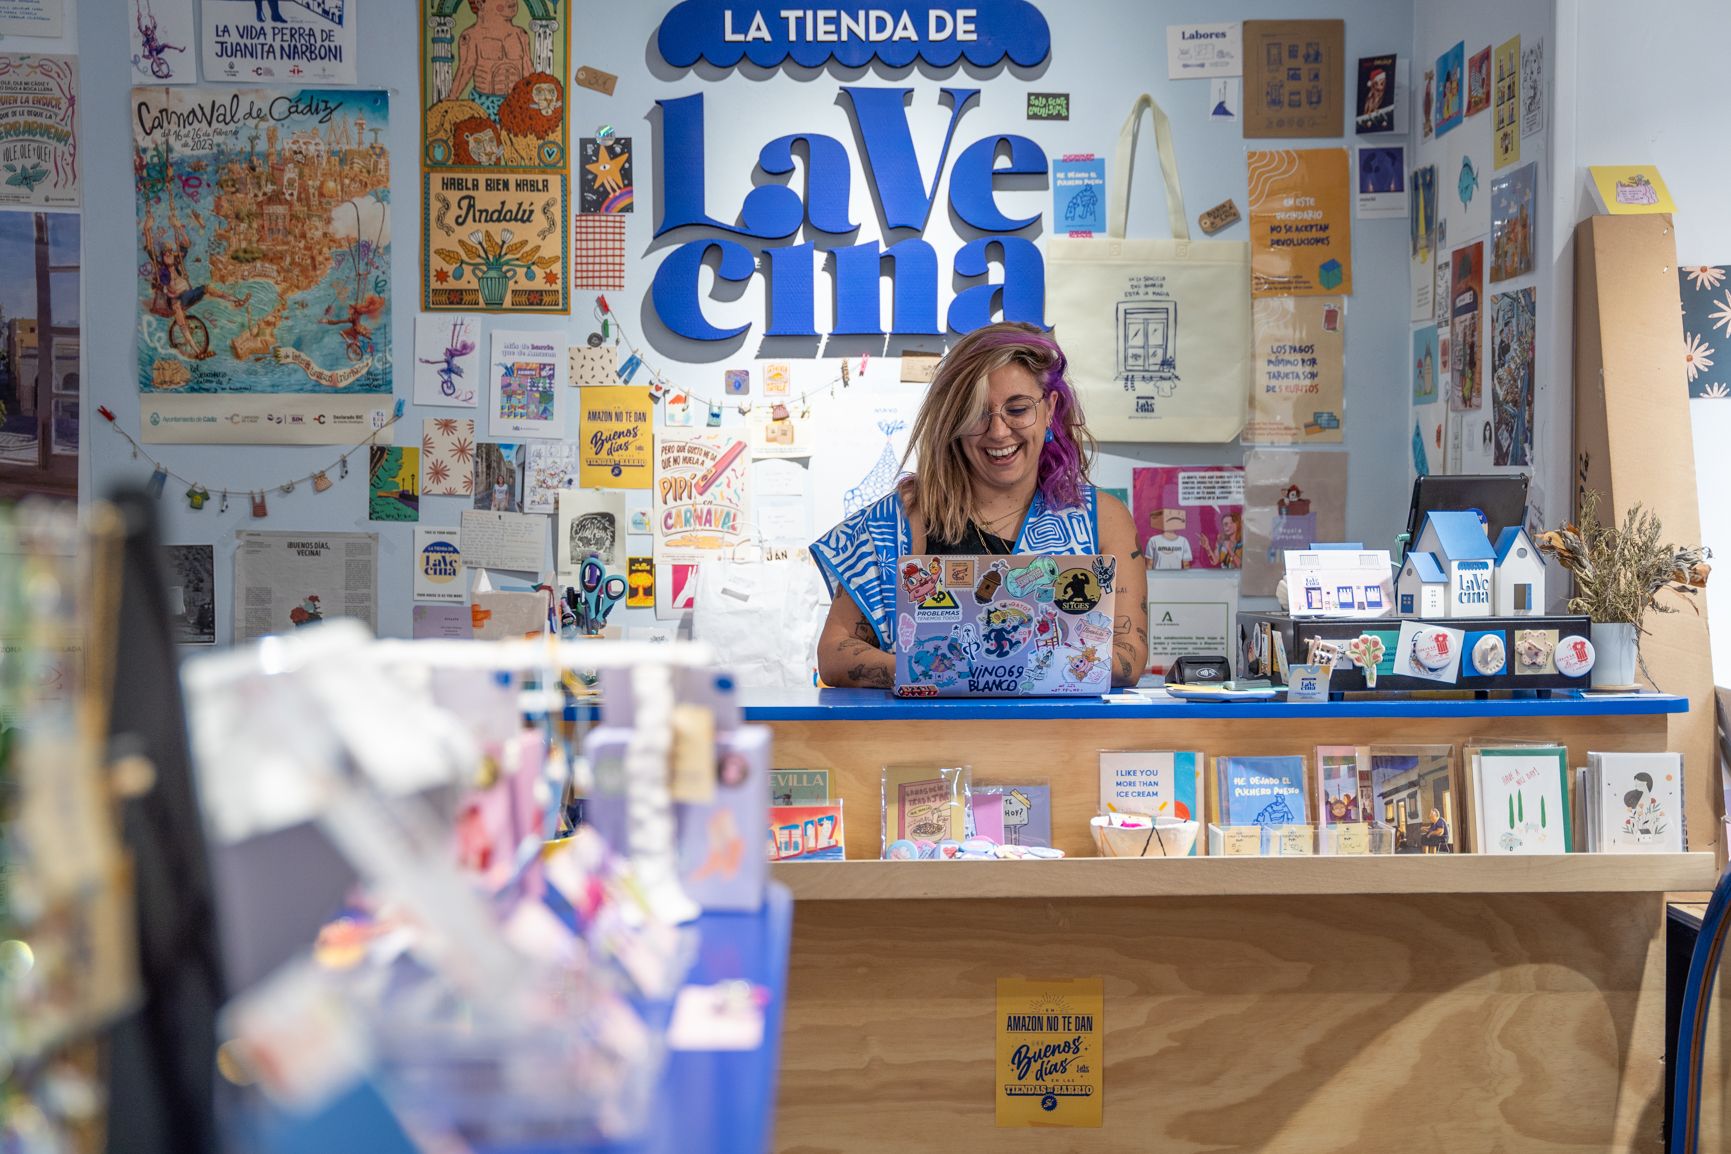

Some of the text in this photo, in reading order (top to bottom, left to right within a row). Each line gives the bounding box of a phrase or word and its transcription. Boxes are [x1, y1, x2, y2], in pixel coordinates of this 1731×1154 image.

[724, 9, 978, 43] LA TIENDA DE
[215, 24, 336, 45] LA VIDA PERRA DE
[1181, 30, 1227, 41] Labores
[214, 41, 343, 63] JUANITA NARBONI
[0, 95, 62, 111] UIEN LA ENSUCIE
[242, 101, 266, 120] de
[269, 95, 343, 124] Cádiz
[20, 142, 32, 160] OLE
[191, 138, 214, 151] 2023
[441, 177, 549, 193] HABLA BIEN HABLA
[1270, 225, 1282, 233] NO
[1295, 223, 1329, 233] ACEPTAN
[1270, 237, 1330, 247] DEVOLUCIONES
[1271, 345, 1315, 354] LOS PAGOS
[1301, 357, 1318, 367] POR
[1266, 371, 1319, 381] TARJETA SON
[1265, 384, 1277, 393] DE
[587, 410, 647, 422] AMAZON NO TE DAN
[590, 425, 639, 456] Buenos
[607, 440, 638, 457] días
[661, 443, 676, 456] PERO
[662, 457, 672, 470] QUE
[673, 455, 681, 467] NO
[682, 456, 699, 465] HUELA
[660, 473, 698, 505] PIPÍ
[664, 507, 738, 532] CARNAVAL
[287, 541, 331, 550] ¡BUENOS DÍAS,
[1062, 601, 1089, 611] SITGES
[968, 679, 1018, 692] BLANCO
[1120, 769, 1137, 777] LIKE
[1139, 769, 1158, 777] YOU
[769, 774, 825, 787] EVILLA
[1249, 776, 1280, 785] DEJADO
[1282, 776, 1291, 784] EL
[1234, 787, 1271, 796] PUCHERO
[1005, 808, 1024, 816] HOY?
[1006, 1015, 1093, 1031] AMAZON NO TE DAN
[1011, 1036, 1083, 1080] Buenos
[1035, 1055, 1083, 1082] días
[1005, 1085, 1094, 1096] TIENDAS BARRIO
